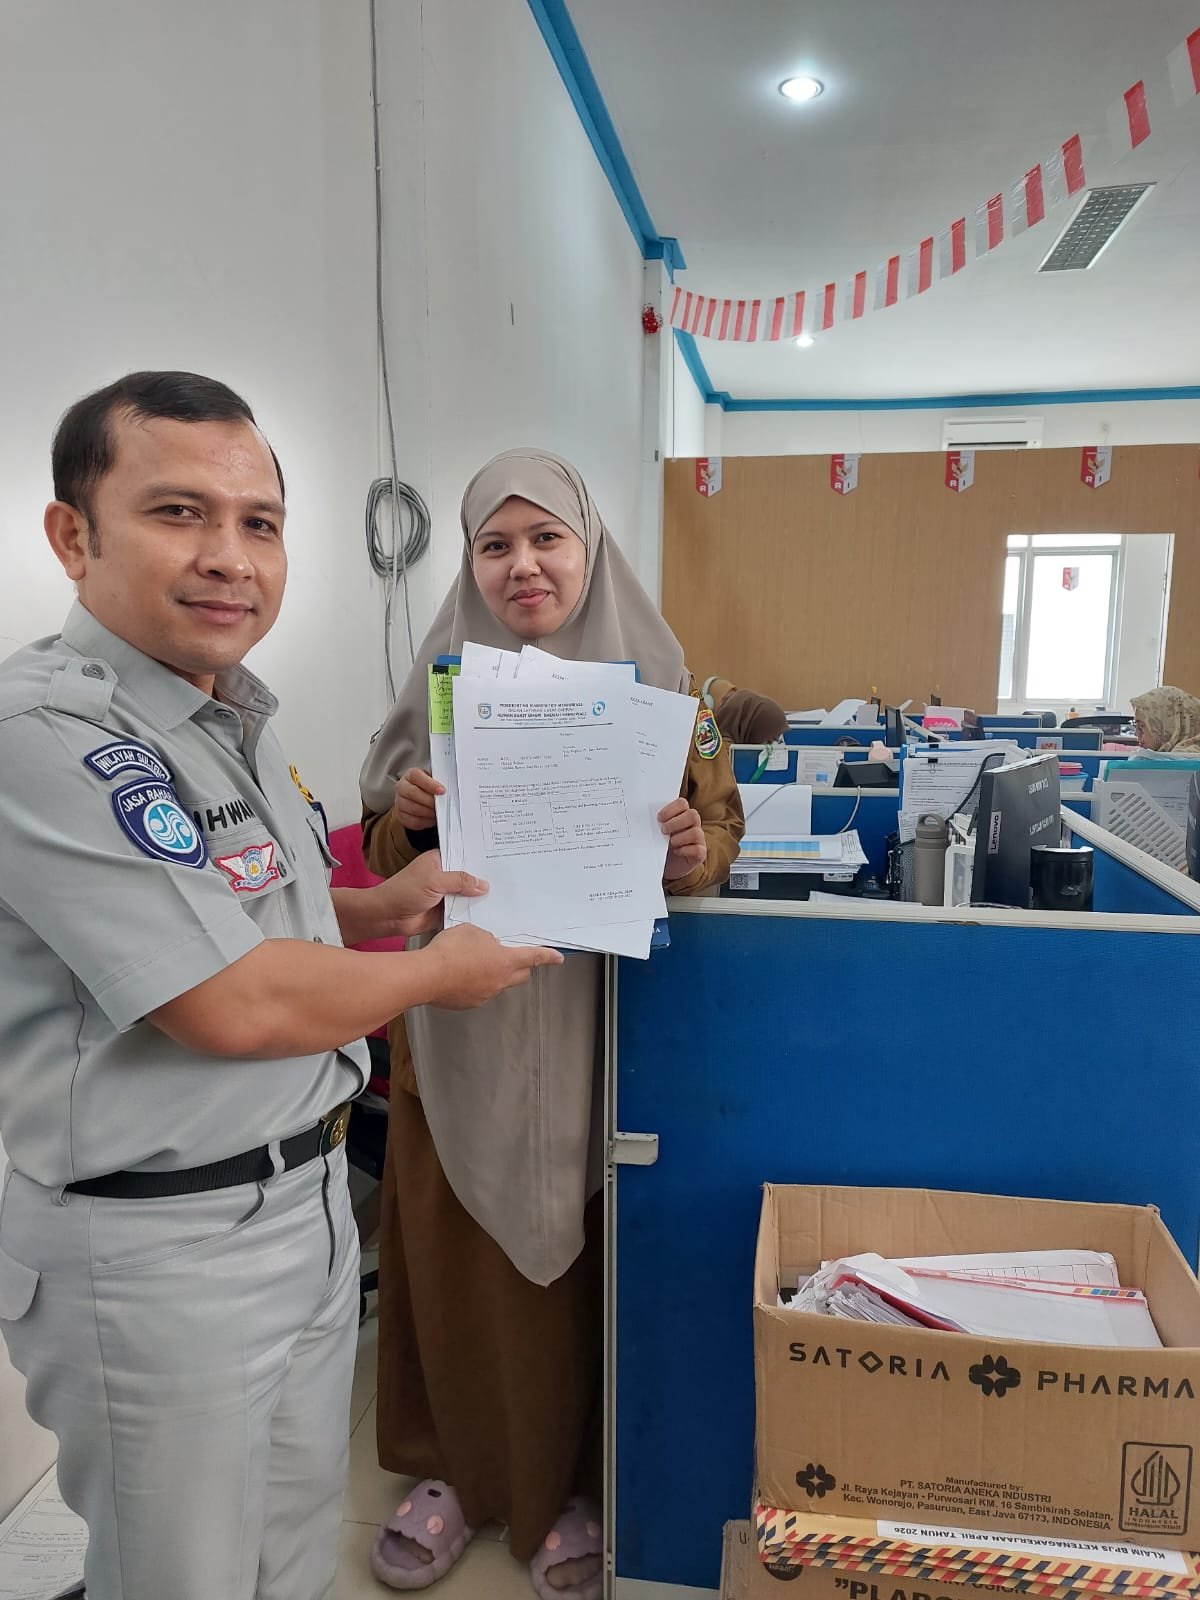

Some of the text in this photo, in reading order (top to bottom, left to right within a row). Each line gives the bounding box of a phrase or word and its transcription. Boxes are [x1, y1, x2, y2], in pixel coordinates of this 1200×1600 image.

[97, 750, 135, 770] WILAYAH
[122, 792, 148, 813] JASA
[789, 1342, 1195, 1399] SATORIA PHARMA
[900, 1480, 1052, 1503] PT. SATORIA ANEKA INDUSTRI
[945, 1476, 1024, 1492] Manufactured by:
[843, 1493, 864, 1503] Kec.
[866, 1495, 915, 1510] Wonorejo,
[917, 1501, 966, 1515] Pasuruan,
[968, 1507, 990, 1517] East
[992, 1509, 1016, 1520] Java
[1018, 1511, 1050, 1524] 67173,
[1052, 1515, 1111, 1531] INDONESIA
[854, 1484, 879, 1495] Raya
[880, 1488, 919, 1500] Kejayan
[927, 1492, 977, 1506] Purwosari
[979, 1499, 998, 1509] KM.
[1001, 1501, 1012, 1510] 16
[1015, 1502, 1071, 1516] Sambisirah
[1073, 1508, 1114, 1521] Selatan,
[1129, 1506, 1179, 1520] HALAL
[894, 1527, 1165, 1560] KLAIM BPJS KETENAGAKERJAAN APRIL TAHUN 2026
